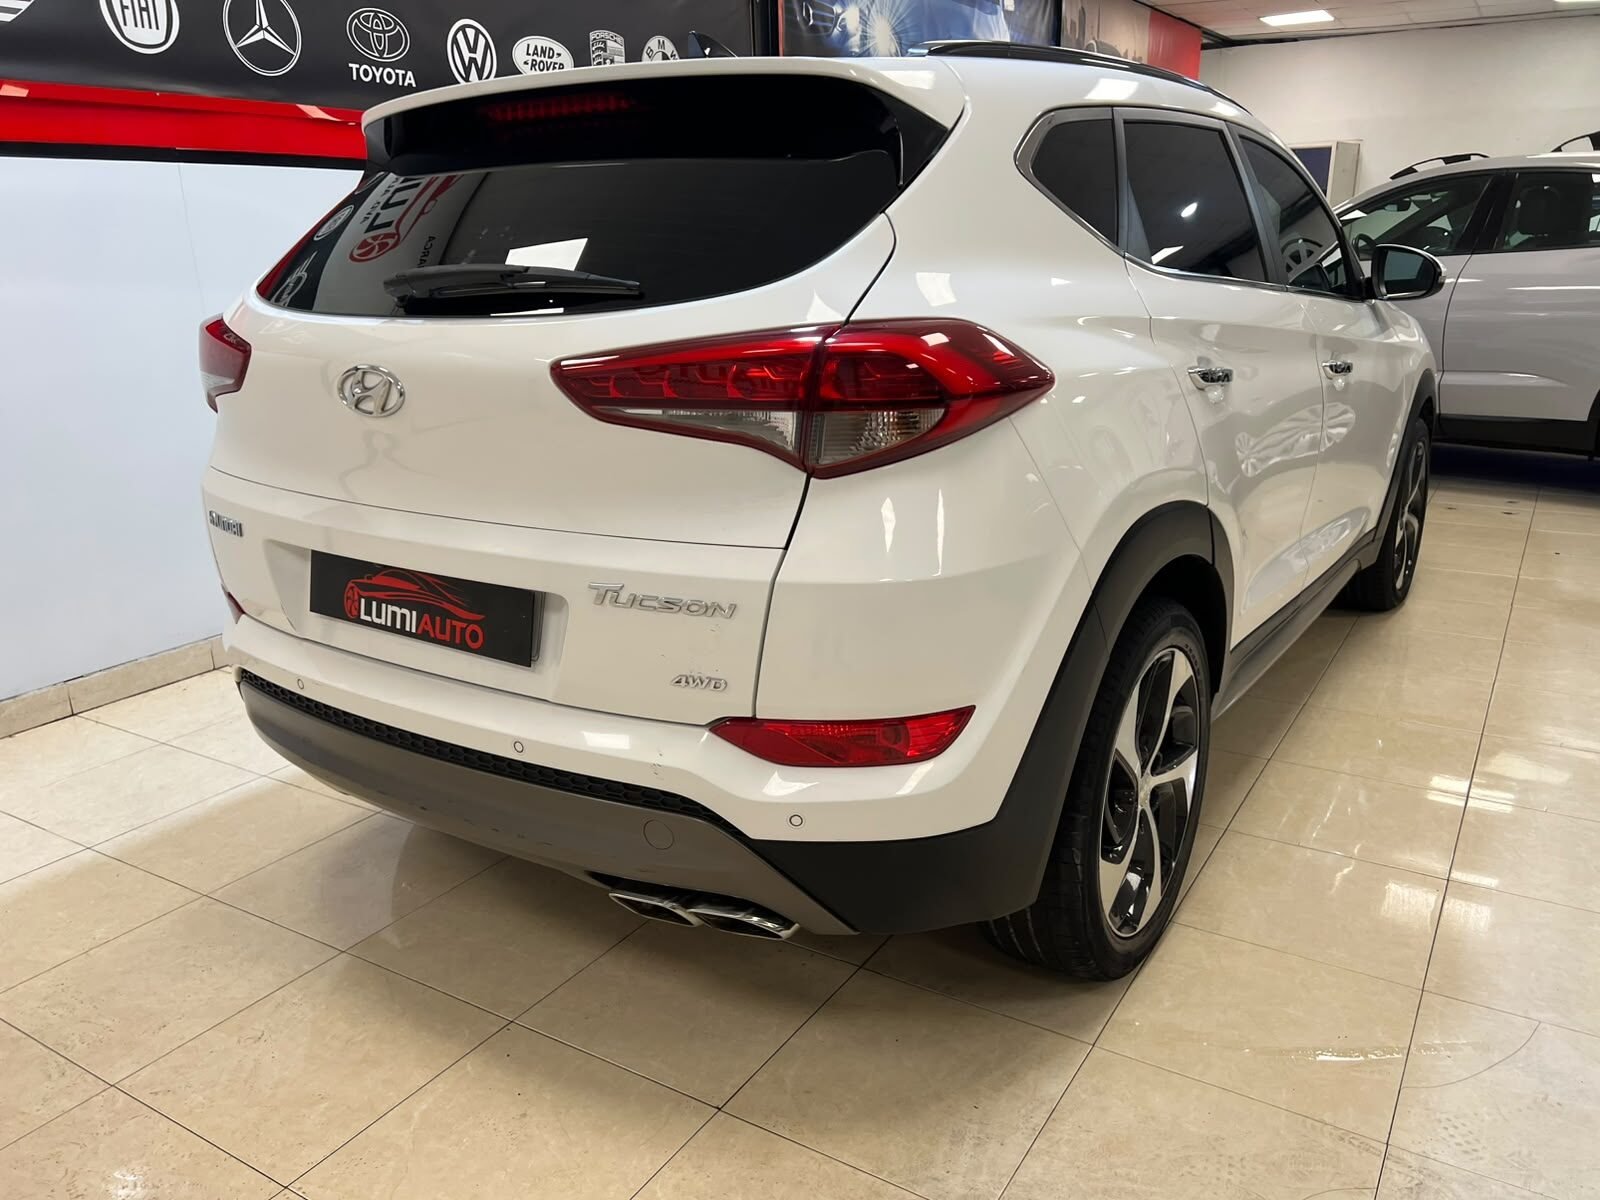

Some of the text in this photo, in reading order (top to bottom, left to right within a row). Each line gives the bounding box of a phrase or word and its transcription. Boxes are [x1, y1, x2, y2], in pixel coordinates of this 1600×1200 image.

[525, 43, 554, 59] LAND
[529, 58, 565, 72] ROVER
[348, 63, 417, 88] TOYOTA
[588, 582, 738, 620] TUCSON
